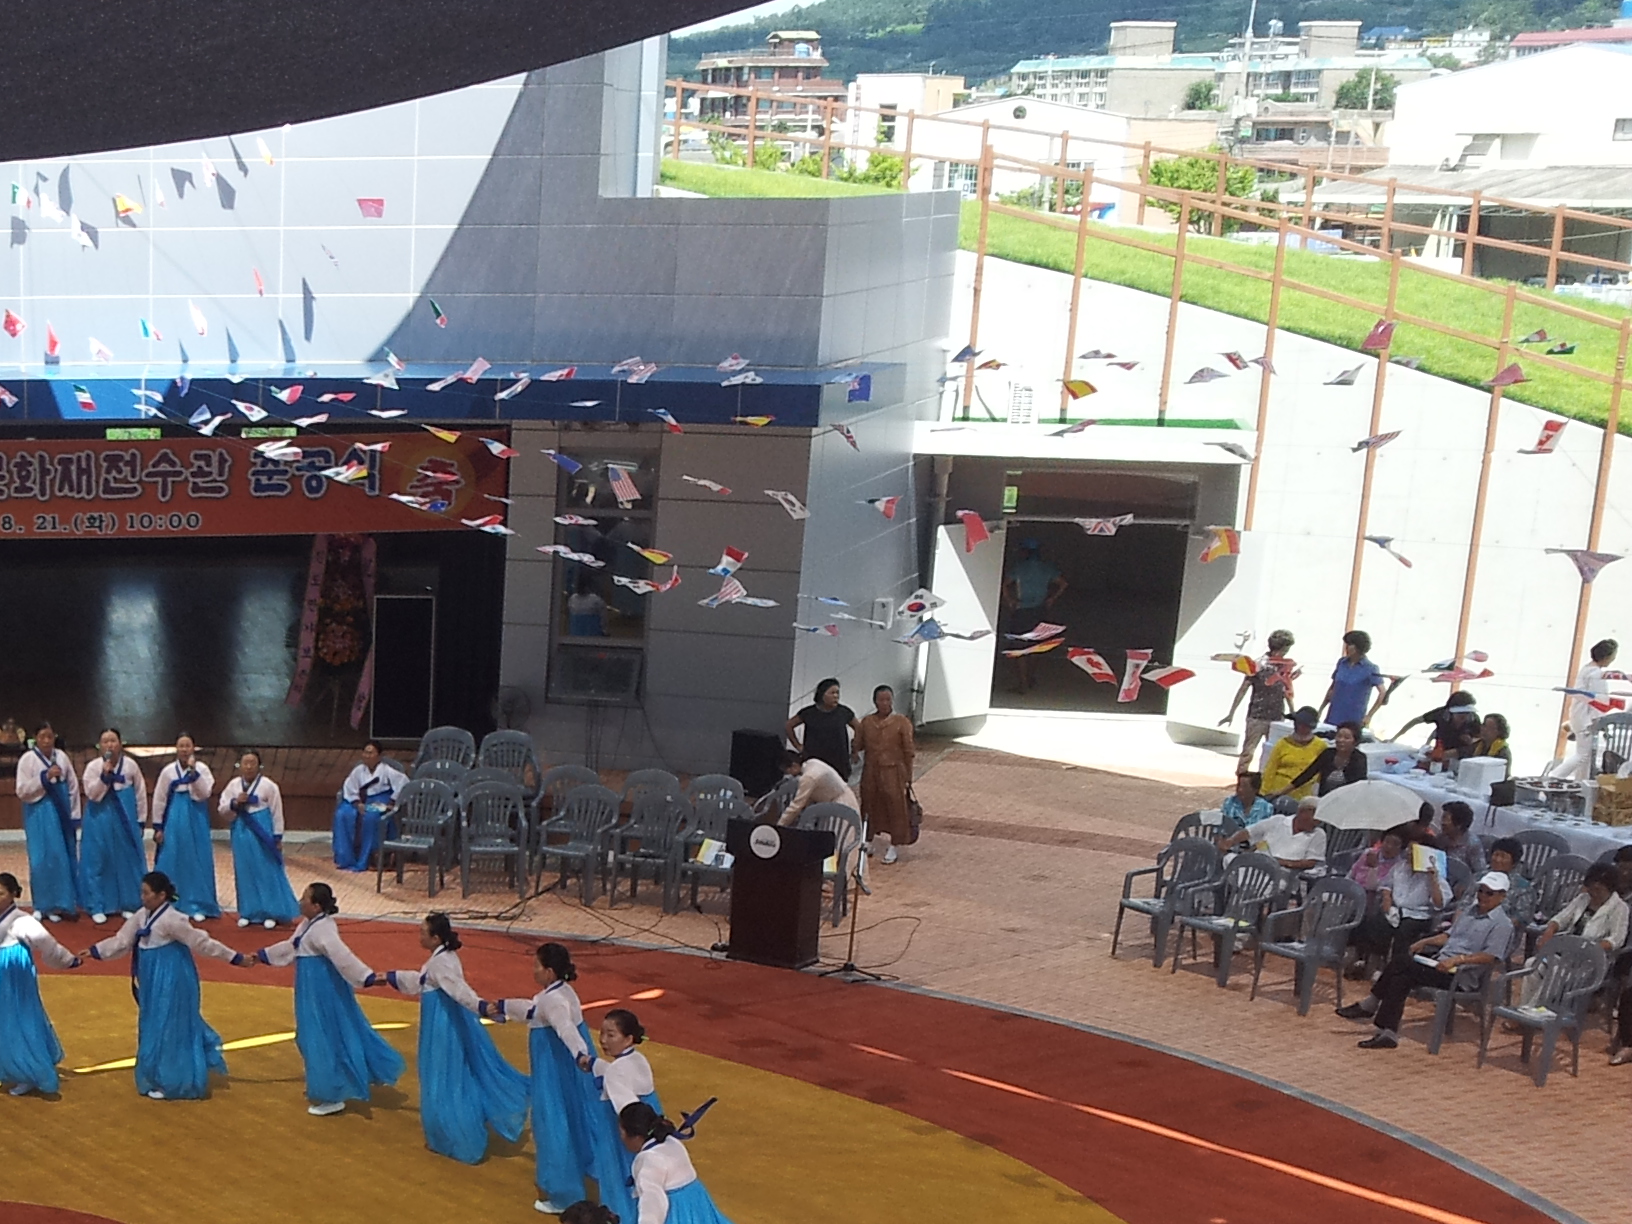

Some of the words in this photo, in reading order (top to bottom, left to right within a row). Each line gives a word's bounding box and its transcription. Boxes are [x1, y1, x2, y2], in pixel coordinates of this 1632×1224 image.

[248, 447, 381, 498] 준공식
[0, 514, 24, 533] 8.
[34, 512, 117, 534] 21.(화)
[126, 512, 201, 531] 10:00
